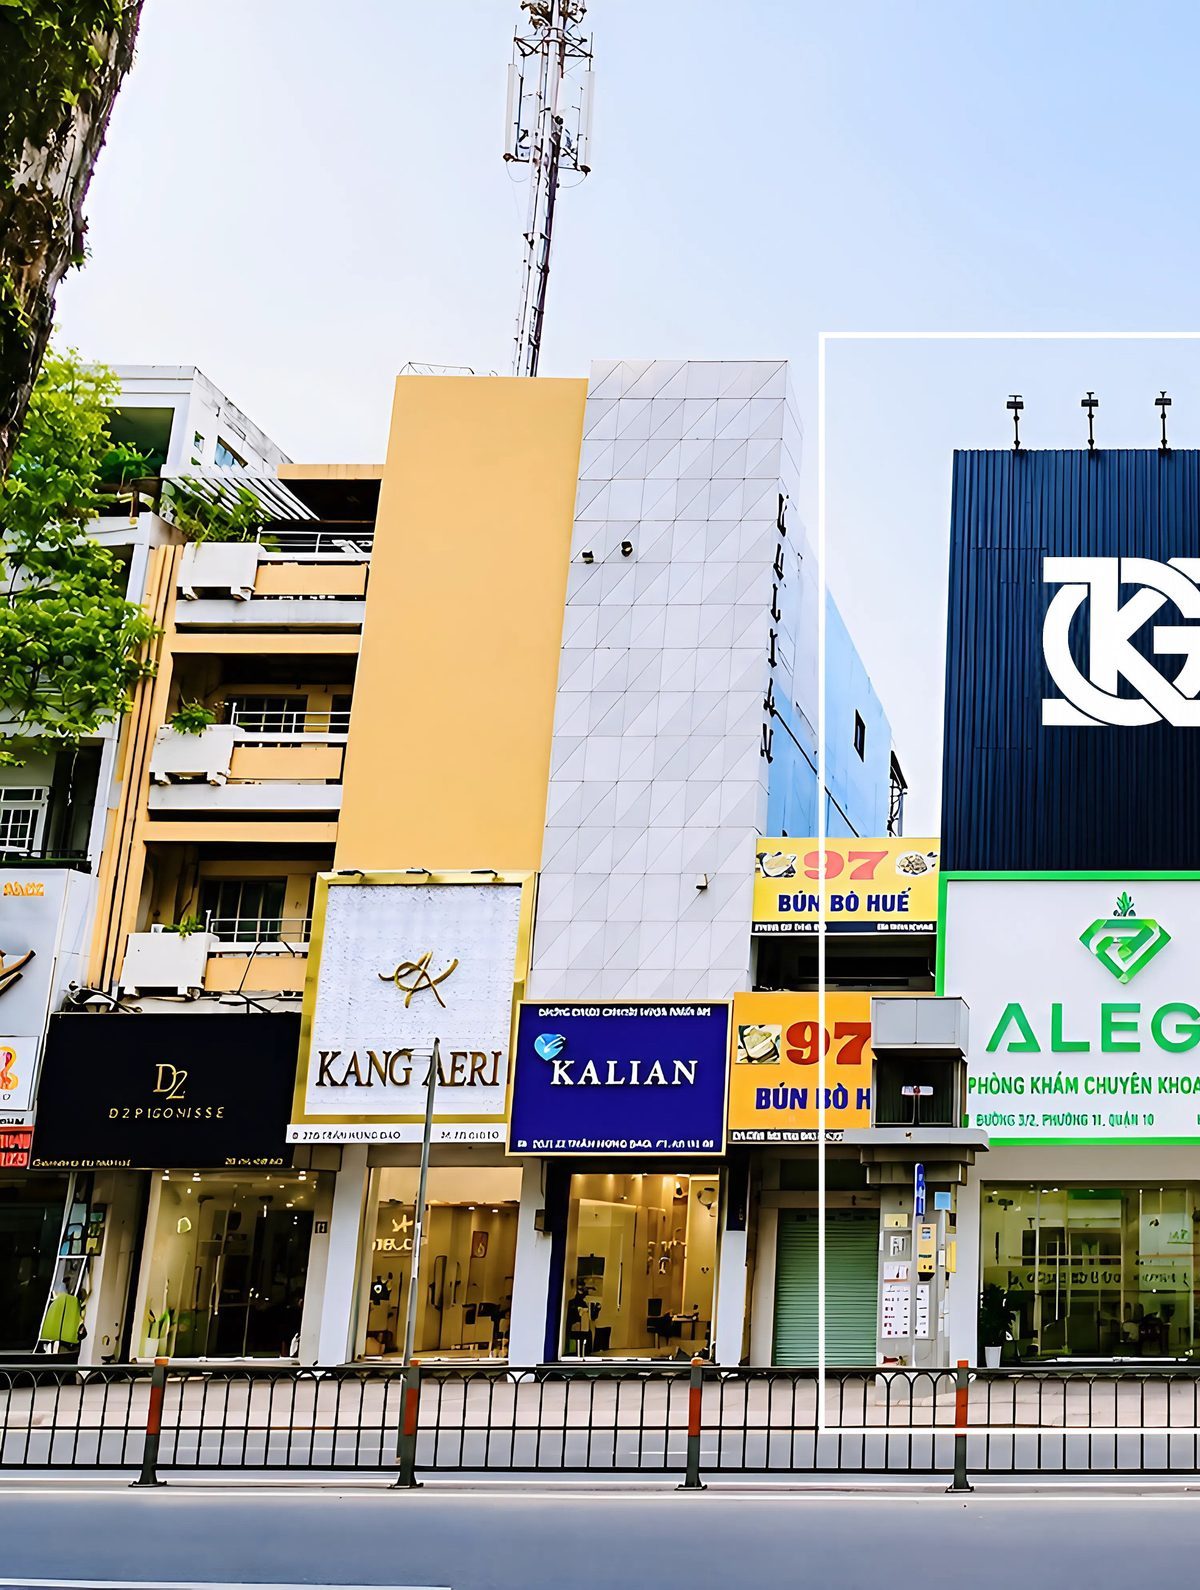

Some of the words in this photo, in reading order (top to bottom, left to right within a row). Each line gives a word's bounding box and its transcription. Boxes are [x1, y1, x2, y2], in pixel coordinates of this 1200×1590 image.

[803, 850, 889, 881] 97
[778, 889, 820, 912] BÚN
[866, 887, 912, 912] HUẾ
[785, 1020, 872, 1066] 97
[152, 1062, 189, 1101] D2
[315, 1050, 413, 1087] KANG
[421, 1050, 503, 1087] AERI
[550, 1059, 698, 1086] KALIAN
[967, 1072, 1025, 1096] PHÒNG
[1030, 1071, 1079, 1095] KHÁM
[1084, 1072, 1152, 1095] CHUYÊN
[755, 1081, 808, 1111] BÚN
